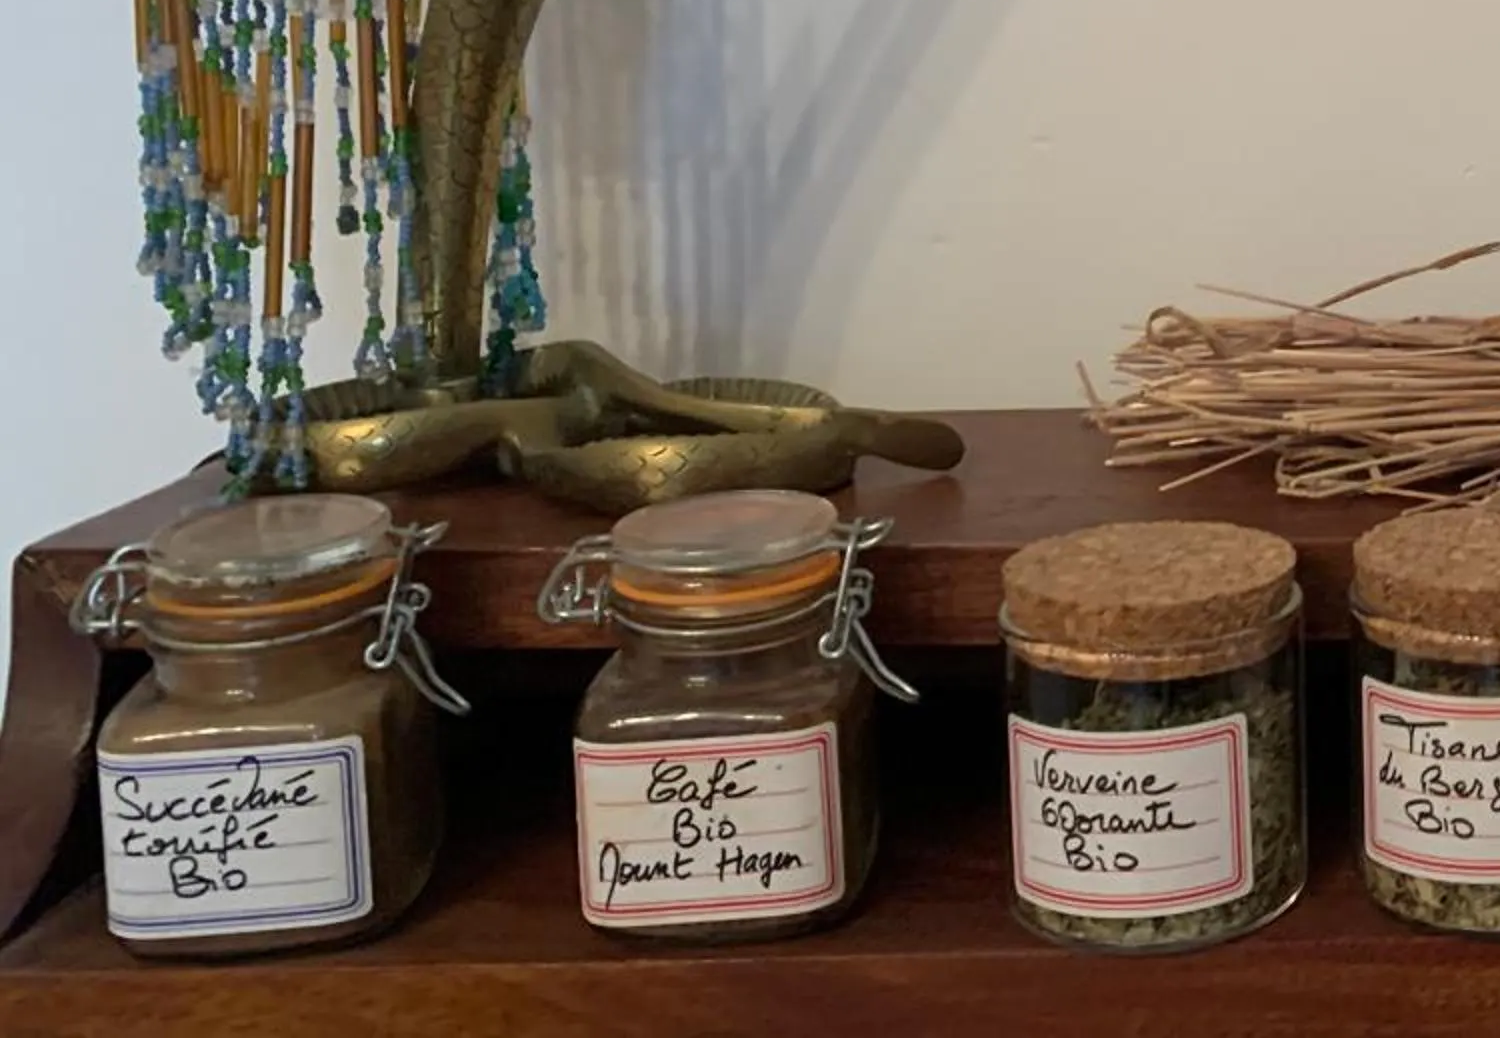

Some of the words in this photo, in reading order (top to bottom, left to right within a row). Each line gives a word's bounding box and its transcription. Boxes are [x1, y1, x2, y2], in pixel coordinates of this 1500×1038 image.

[115, 755, 319, 822] Succédané
[647, 759, 758, 810] Café
[1034, 749, 1178, 795] Verveine
[1379, 750, 1405, 789] du
[672, 808, 737, 847] Bio
[1405, 799, 1474, 839] Bio
[716, 846, 802, 889] Hagen
[1063, 833, 1139, 872] Bio
[169, 855, 247, 898] Bio
